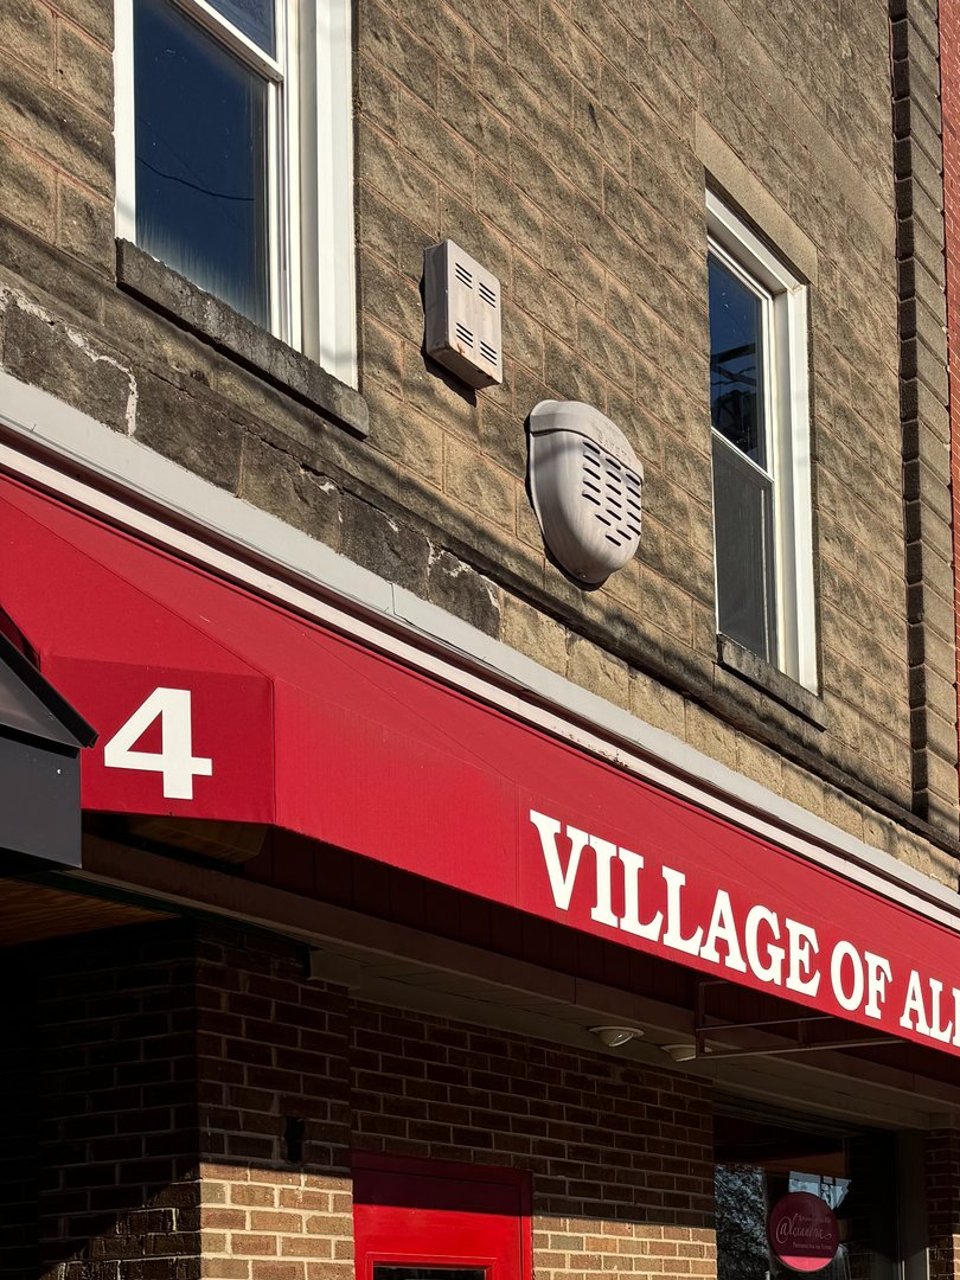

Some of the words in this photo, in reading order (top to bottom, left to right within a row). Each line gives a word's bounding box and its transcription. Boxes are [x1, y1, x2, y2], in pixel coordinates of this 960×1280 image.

[104, 687, 212, 799] 4
[530, 810, 820, 997] VILLAGE
[831, 941, 893, 1020] OF
